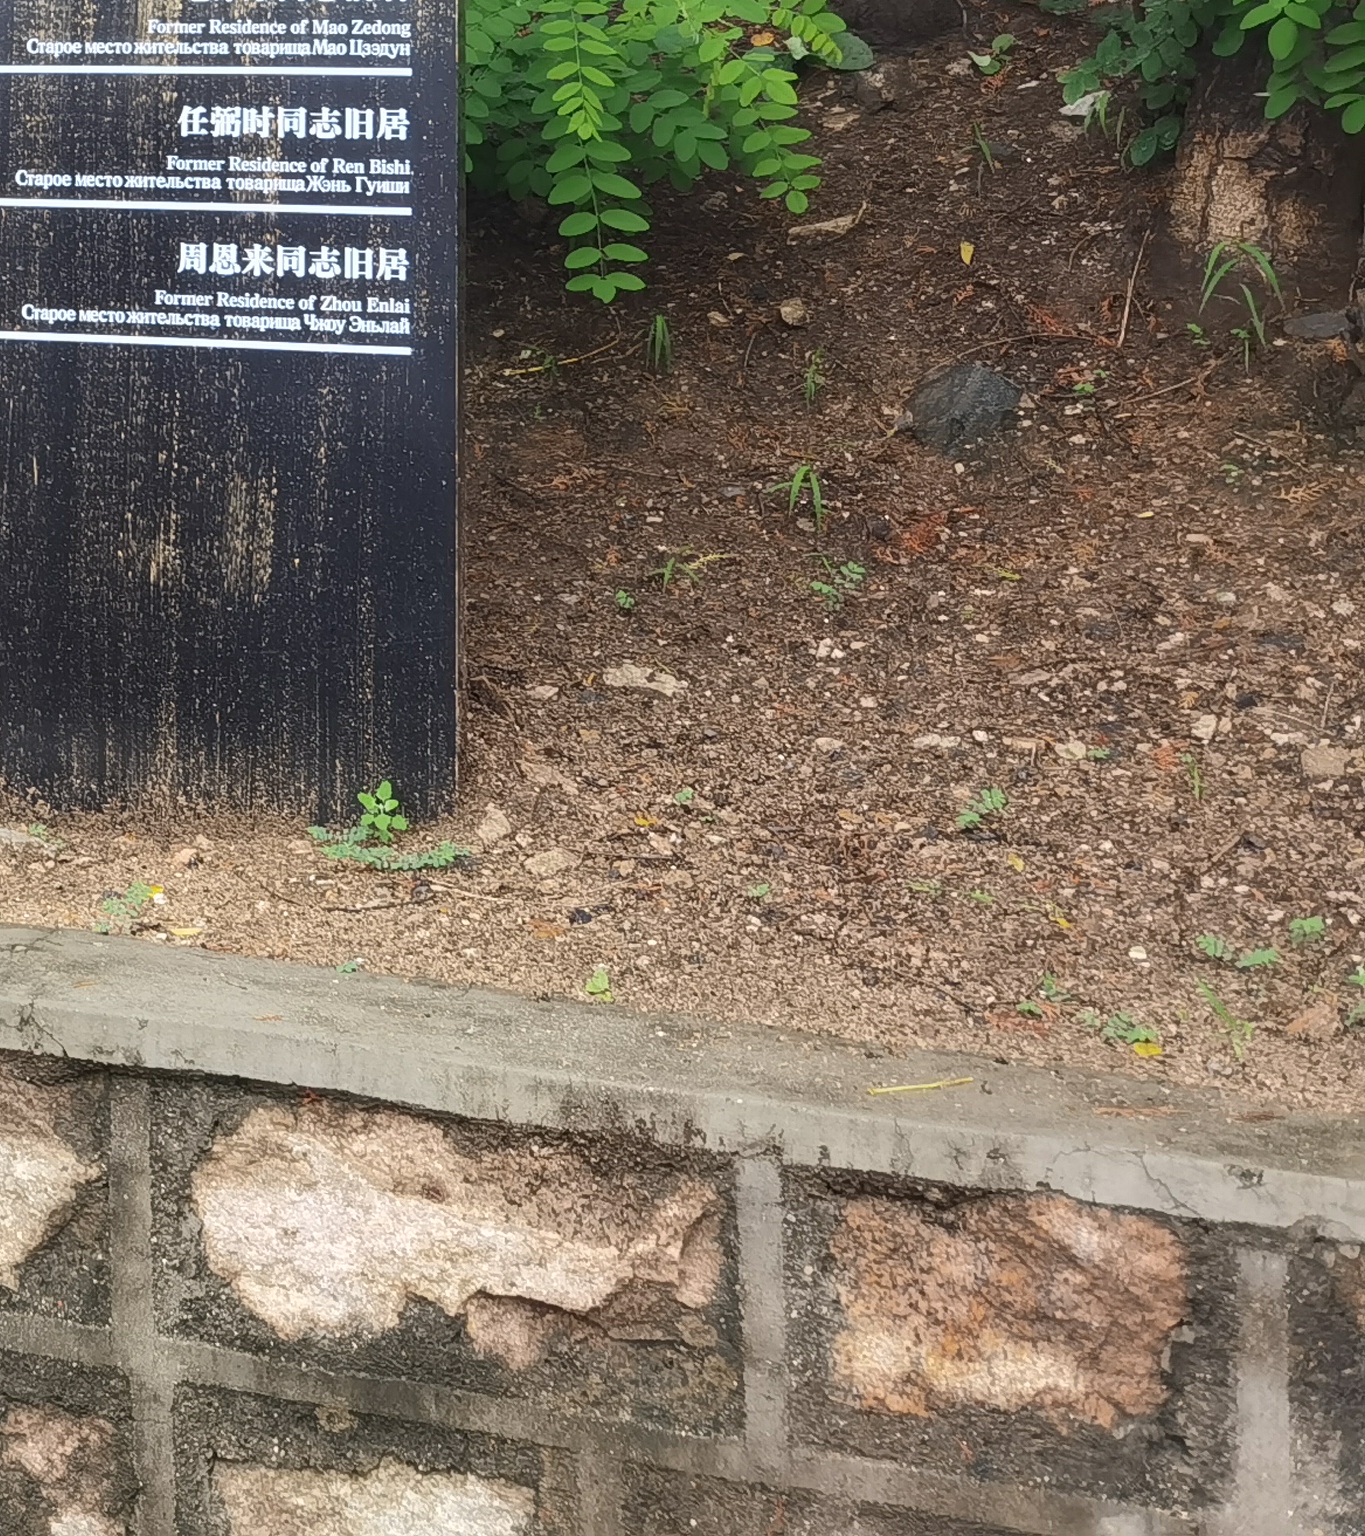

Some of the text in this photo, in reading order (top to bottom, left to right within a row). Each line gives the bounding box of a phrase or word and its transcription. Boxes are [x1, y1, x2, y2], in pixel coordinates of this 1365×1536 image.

[147, 18, 411, 38] Former Residence of Mao Zedong
[26, 38, 82, 58] Старое
[85, 41, 133, 55] место
[134, 40, 230, 55] жительства
[312, 39, 347, 55] Мао
[178, 105, 411, 140] 任弼时同志旧居
[166, 155, 225, 172] Former
[228, 156, 307, 173] Residence
[310, 157, 330, 173] of
[333, 158, 365, 174] Ren
[15, 169, 72, 190] Старое
[75, 173, 123, 188] место
[124, 174, 222, 191] жительства
[177, 242, 410, 281] 周恩来同志旧居
[154, 290, 411, 314] Former Residence of Zhou Enlai
[21, 304, 77, 324] Старое
[79, 309, 126, 323] место
[126, 310, 220, 328] жительства
[348, 316, 411, 335] Эньлай
